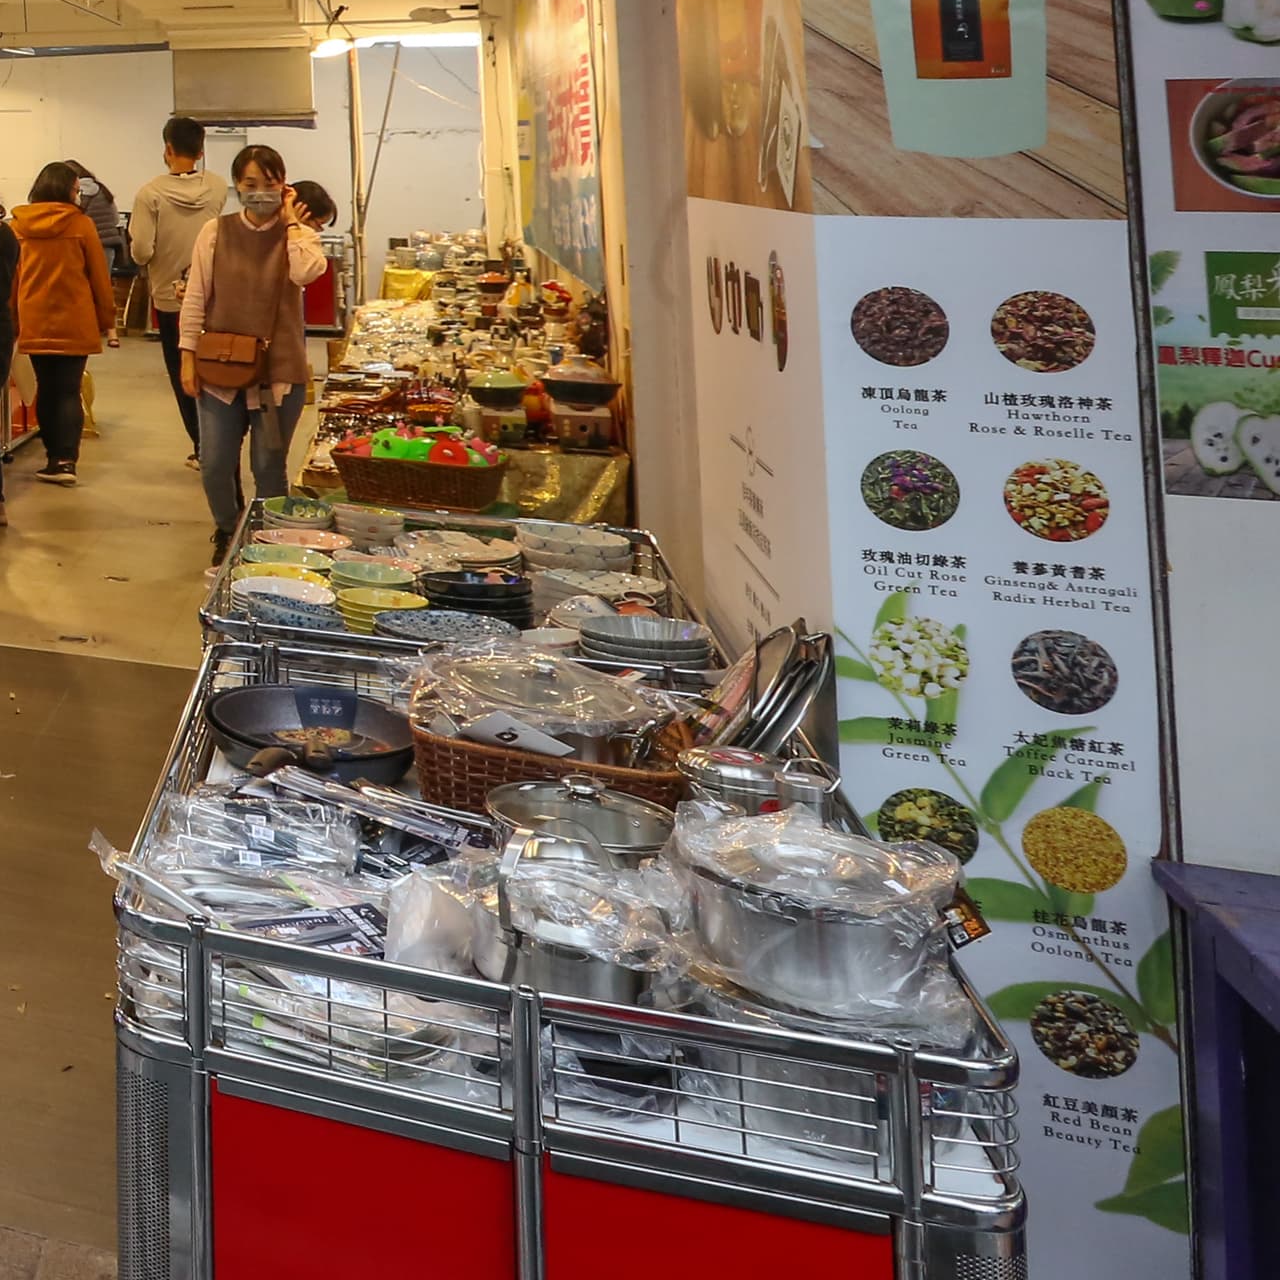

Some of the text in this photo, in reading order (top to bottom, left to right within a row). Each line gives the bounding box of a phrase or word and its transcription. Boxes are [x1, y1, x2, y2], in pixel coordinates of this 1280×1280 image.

[861, 387, 948, 403] 凍頂烏龍茶
[984, 392, 1113, 411] 山楂玫瑰洛神茶
[880, 404, 930, 417] Oolong
[1007, 409, 1092, 424] Hawthorn
[893, 420, 918, 431] Tea
[969, 423, 1133, 442] Rose & Roselle Tea
[861, 548, 967, 569] 玫瑰油切綠茶
[864, 565, 967, 583] Oil Cut Rose
[874, 581, 958, 598] Green Tea
[1065, 581, 1138, 598] Astragali
[992, 591, 1132, 613] Radix Herbal Tea
[887, 716, 958, 737] 茉莉綠茶
[888, 732, 953, 750] Jasmine
[1012, 730, 1125, 756] 太妃焦糖紅茶
[882, 747, 967, 768] Green Tea
[1002, 745, 1136, 772] Toffee Caramel
[1028, 764, 1112, 785] Black Tea
[1033, 908, 1128, 936] 桂花烏龍茶
[1031, 925, 1130, 951] Osmanthus
[1030, 941, 1134, 967] Oolong Tea
[1042, 1093, 1139, 1124] 紅豆美顏茶
[1050, 1111, 1133, 1137] Red Bean
[1042, 1125, 1142, 1155] Beauty Tea
